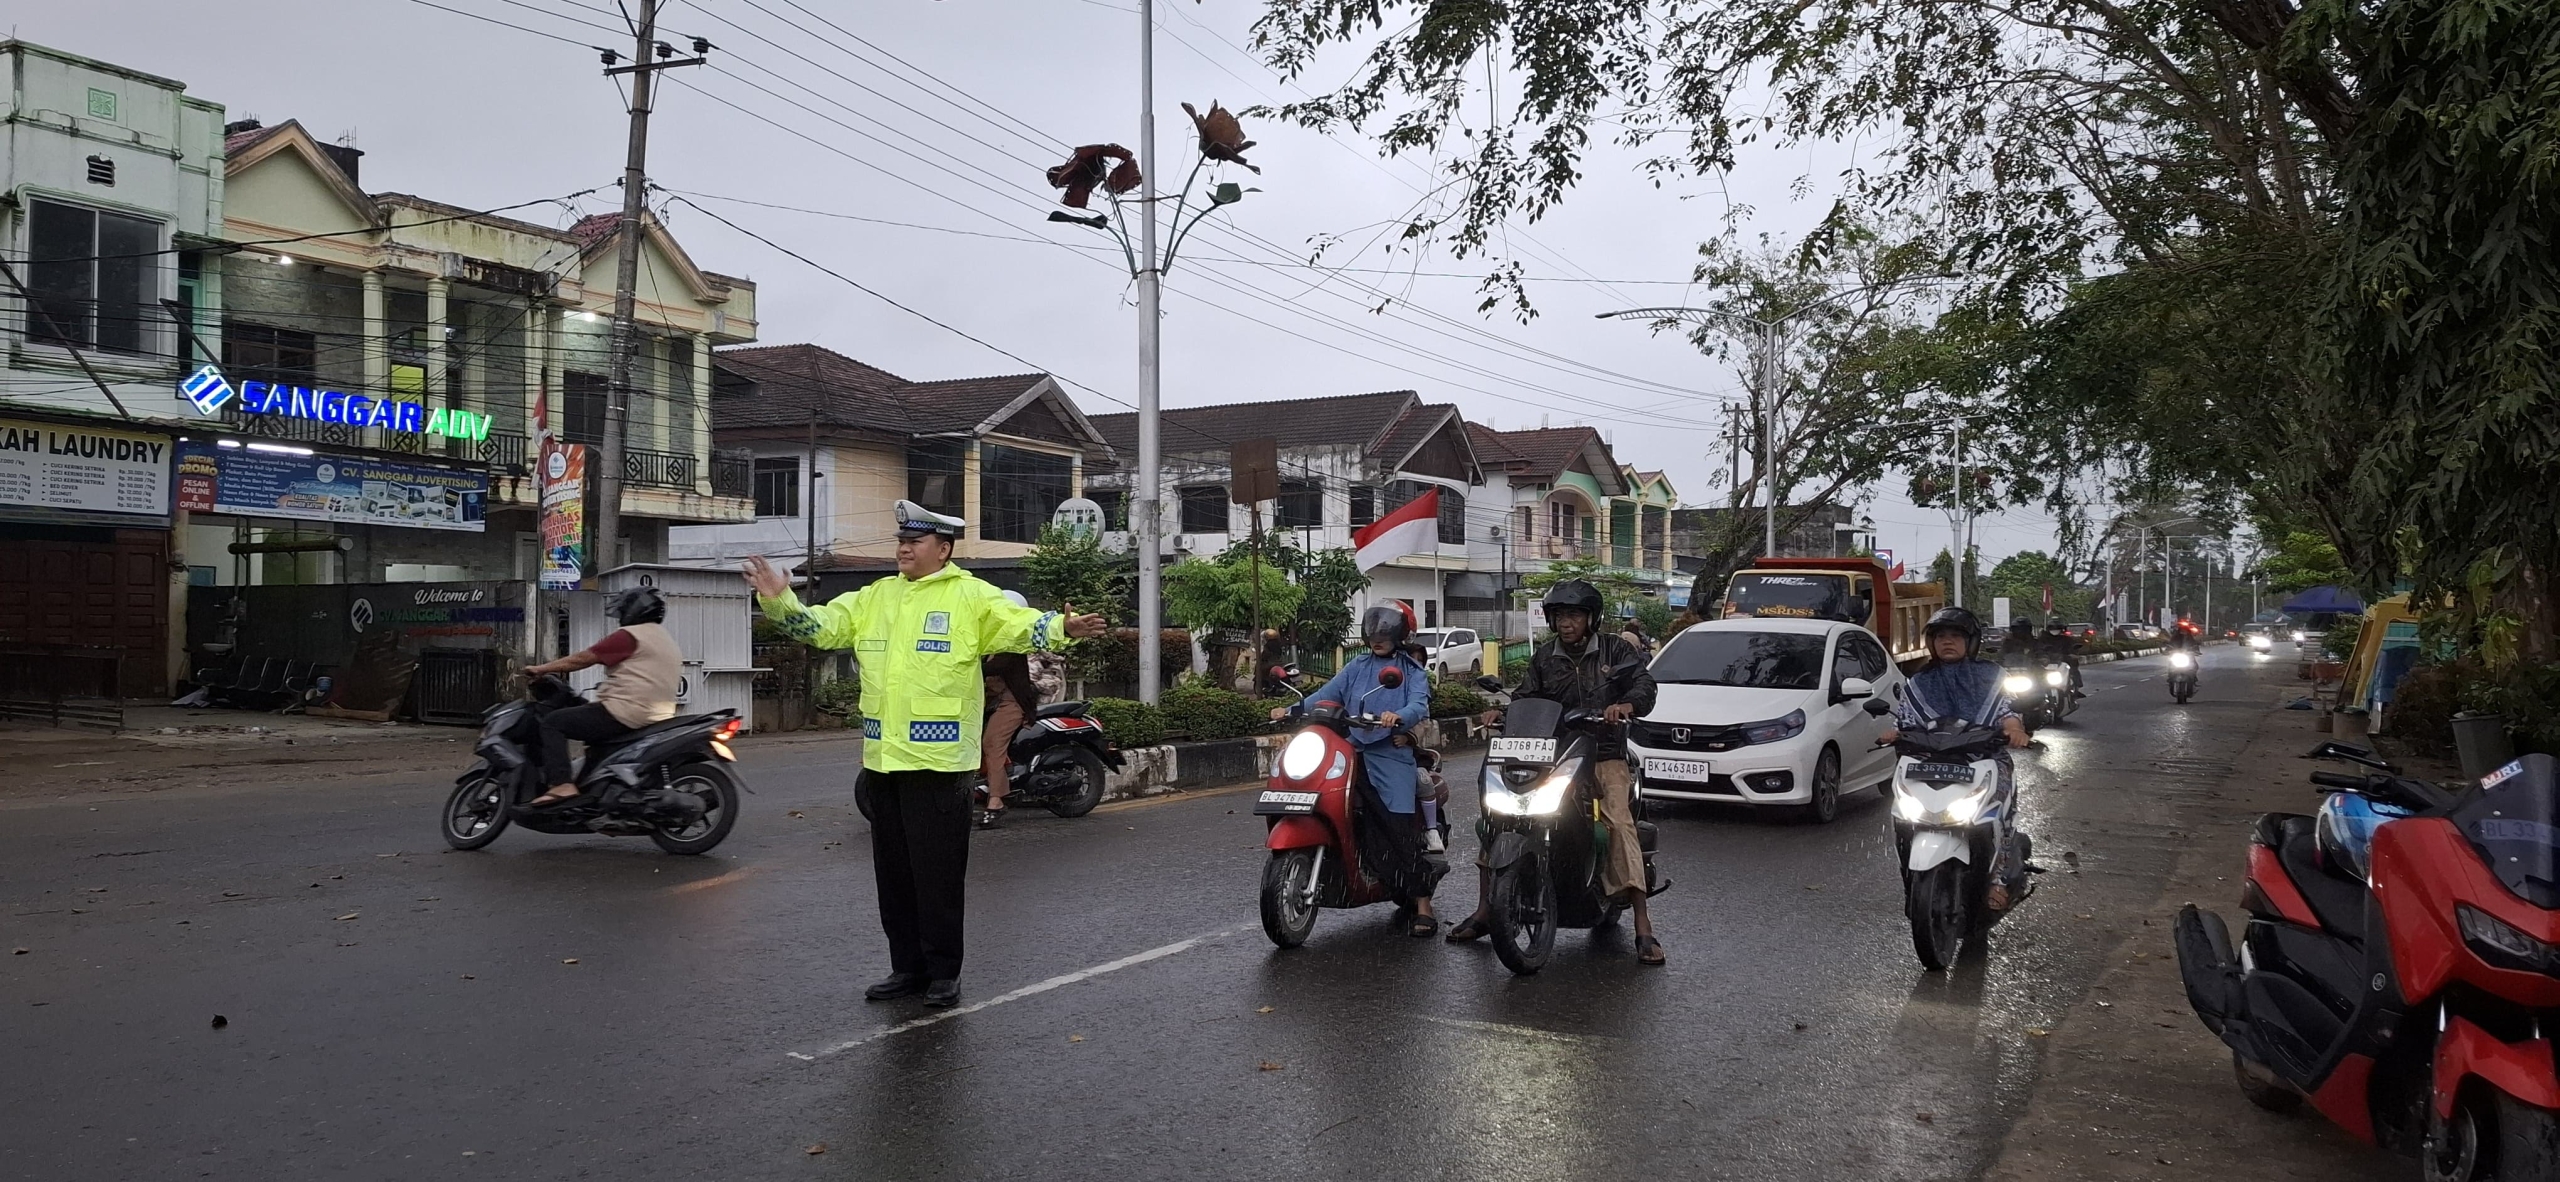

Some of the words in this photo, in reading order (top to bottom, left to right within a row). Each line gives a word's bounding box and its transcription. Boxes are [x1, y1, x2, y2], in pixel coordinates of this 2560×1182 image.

[239, 380, 423, 433] SANGGAR
[425, 407, 492, 440] ADV
[49, 432, 164, 464] LAUNDRY
[183, 455, 215, 465] SPECIAL
[178, 463, 218, 476] PROMO
[183, 479, 209, 488] PESAN
[341, 467, 360, 477] CV.
[363, 469, 414, 483] SANGGAR
[415, 474, 479, 488] ADVERTISING
[182, 487, 210, 495] ONLINE
[179, 501, 210, 509] OFFLINE
[414, 588, 469, 605] Welcome
[471, 588, 484, 602] to
[917, 641, 950, 652] POLISI
[1493, 740, 1504, 750] BL
[1507, 740, 1531, 750] 3768
[1534, 741, 1555, 751] FAJ
[2483, 763, 2520, 786] MJRT
[1262, 793, 1272, 801] BL
[1275, 794, 1297, 802] 3476
[1297, 795, 1315, 803] FAJ
[2485, 821, 2508, 837] BL
